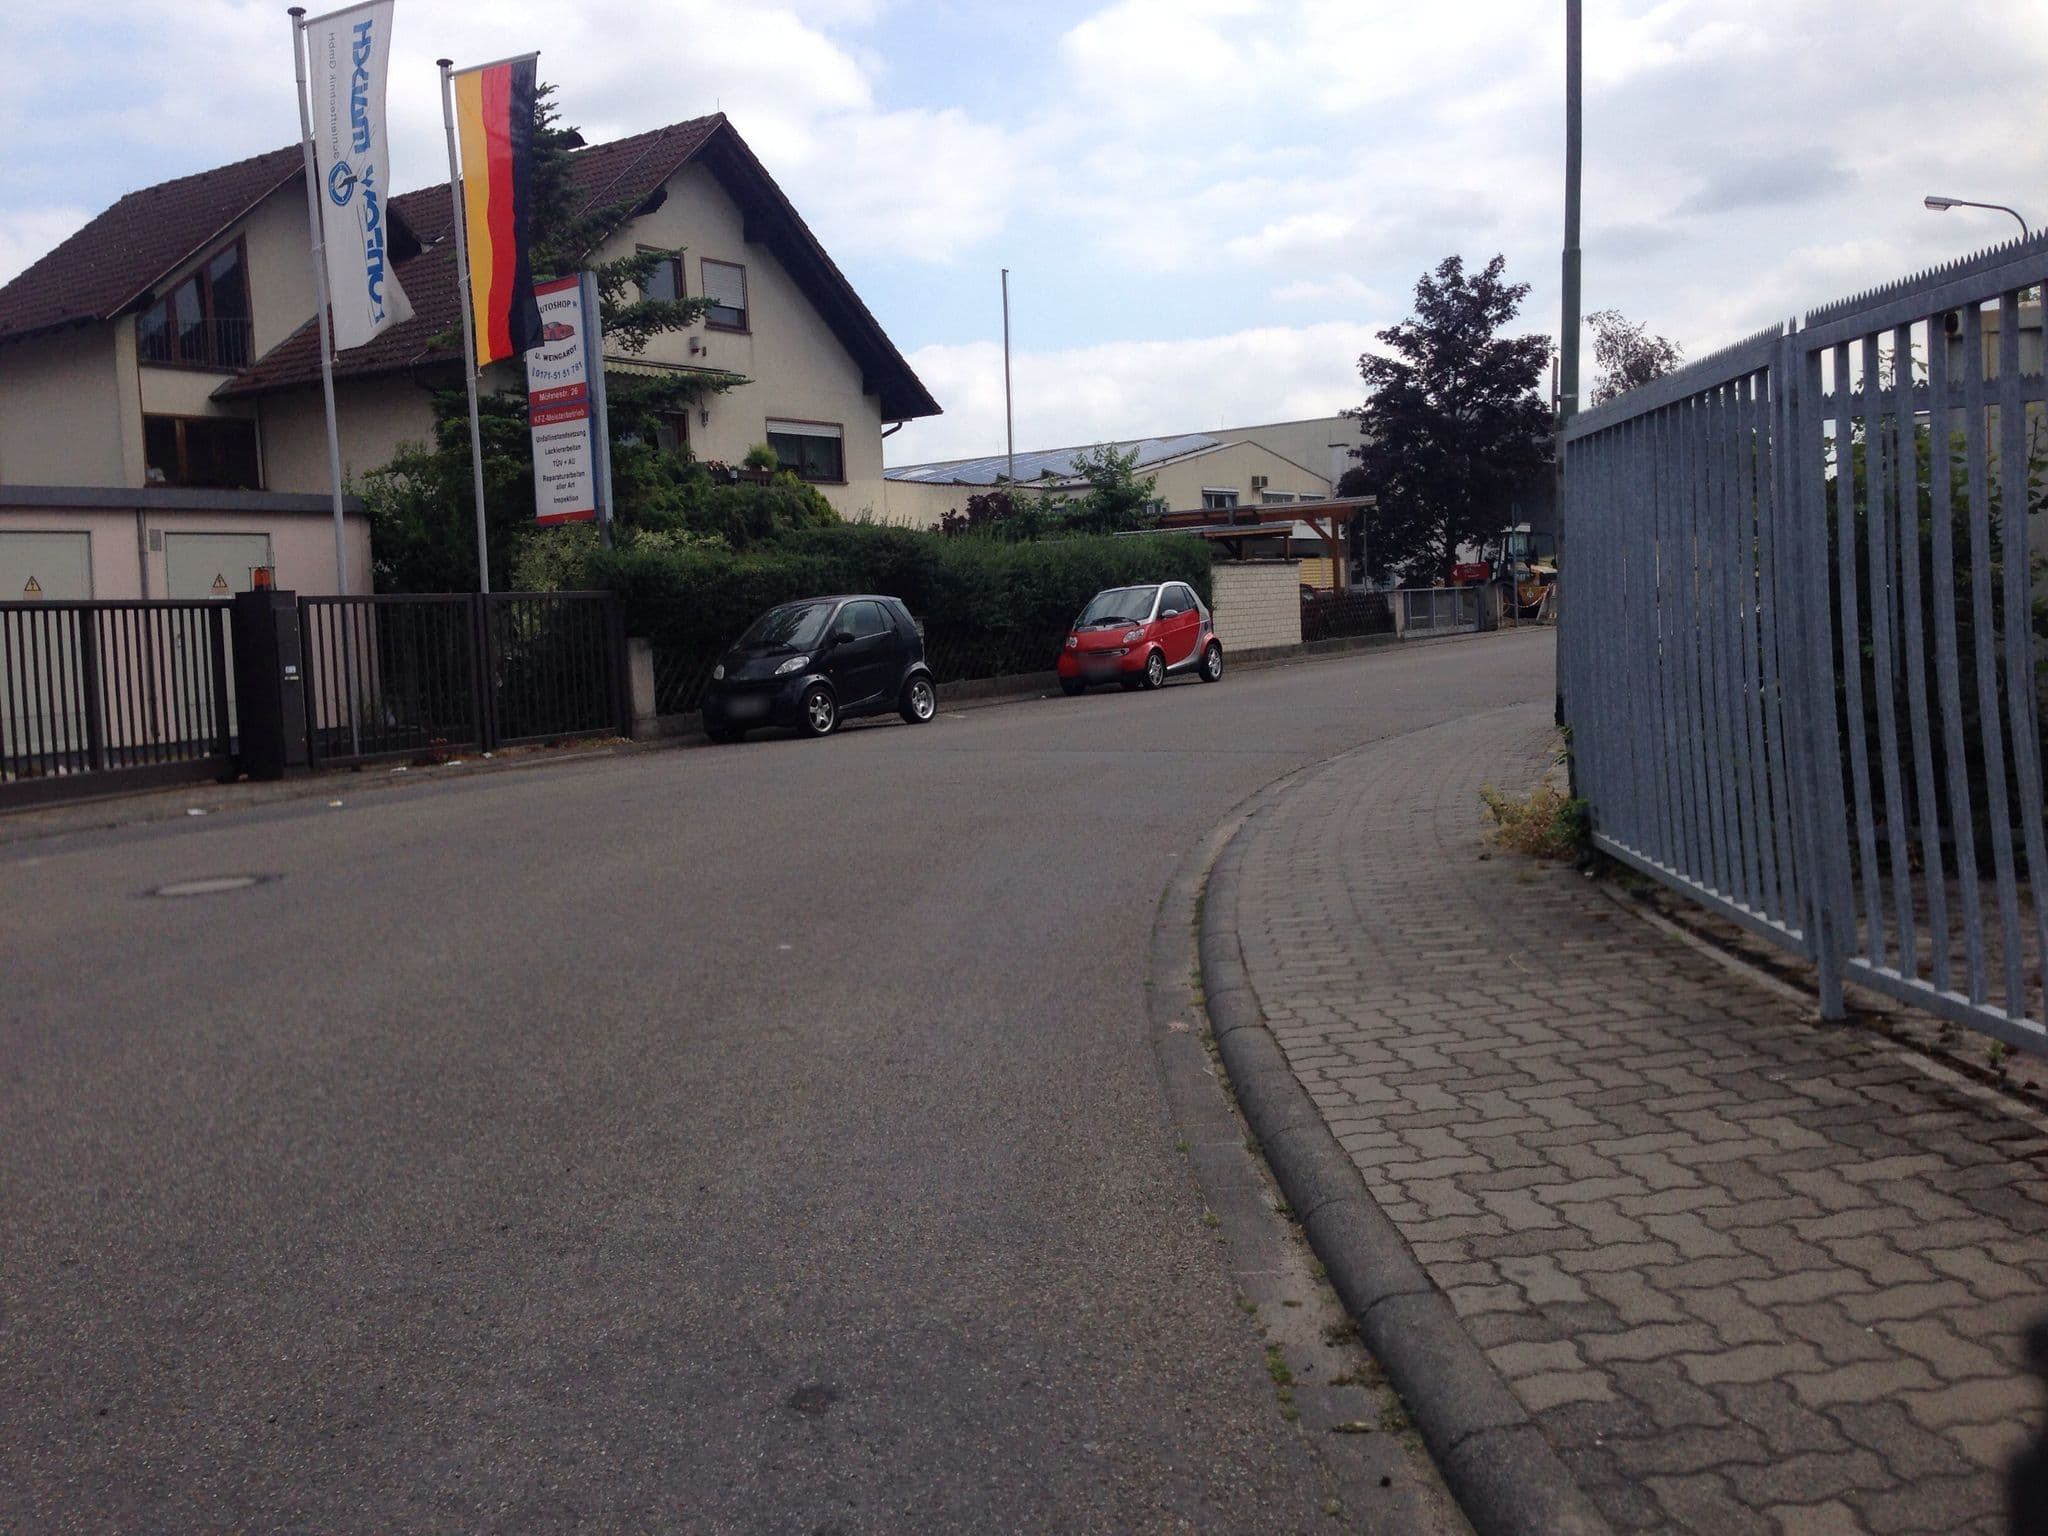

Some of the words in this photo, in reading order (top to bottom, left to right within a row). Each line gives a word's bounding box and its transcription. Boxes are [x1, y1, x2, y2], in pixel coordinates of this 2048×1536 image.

[540, 300, 571, 313] UTOSHOP
[544, 444, 581, 455] Lackierarbeiten
[542, 471, 585, 482] Reparaturarbeiten
